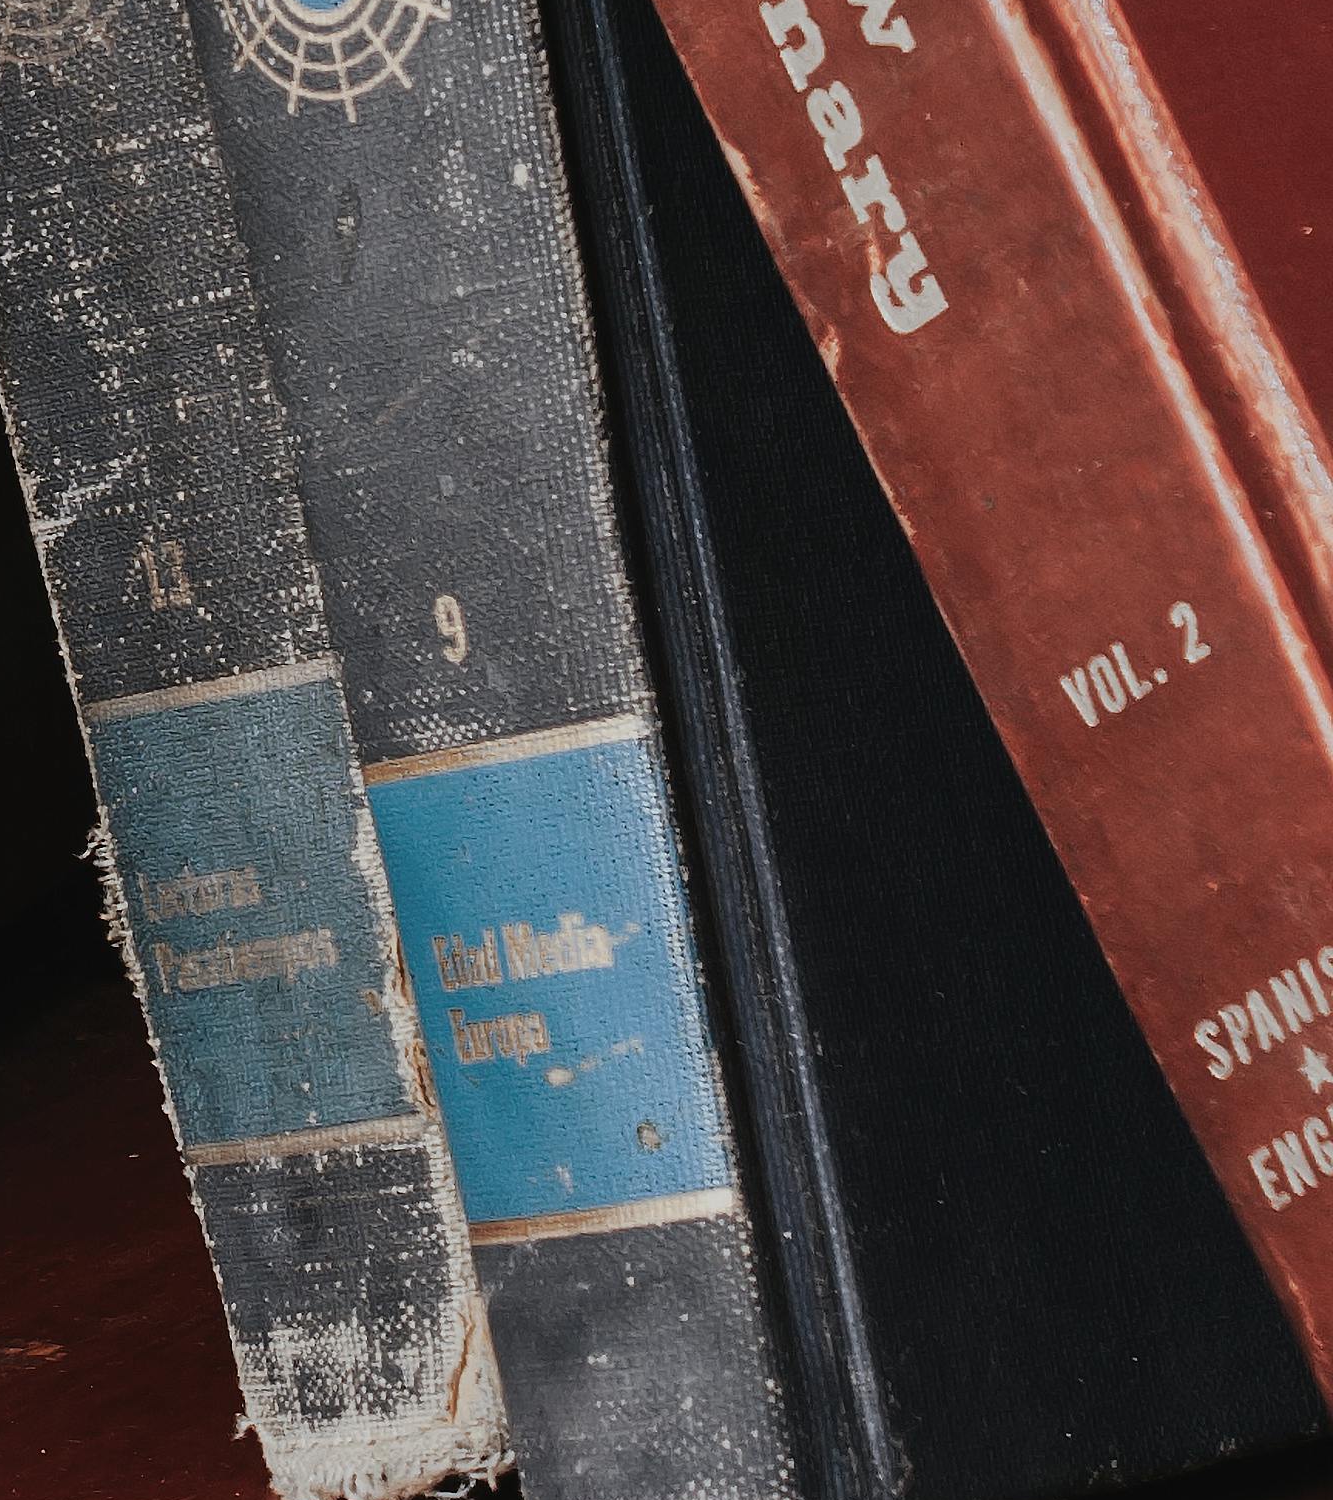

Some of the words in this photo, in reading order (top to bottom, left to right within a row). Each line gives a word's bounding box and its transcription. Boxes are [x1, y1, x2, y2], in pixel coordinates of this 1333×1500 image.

[434, 594, 469, 665] 9
[1060, 640, 1168, 728] VOL.
[1169, 600, 1212, 664] 2
[449, 1008, 551, 1067] Europa
